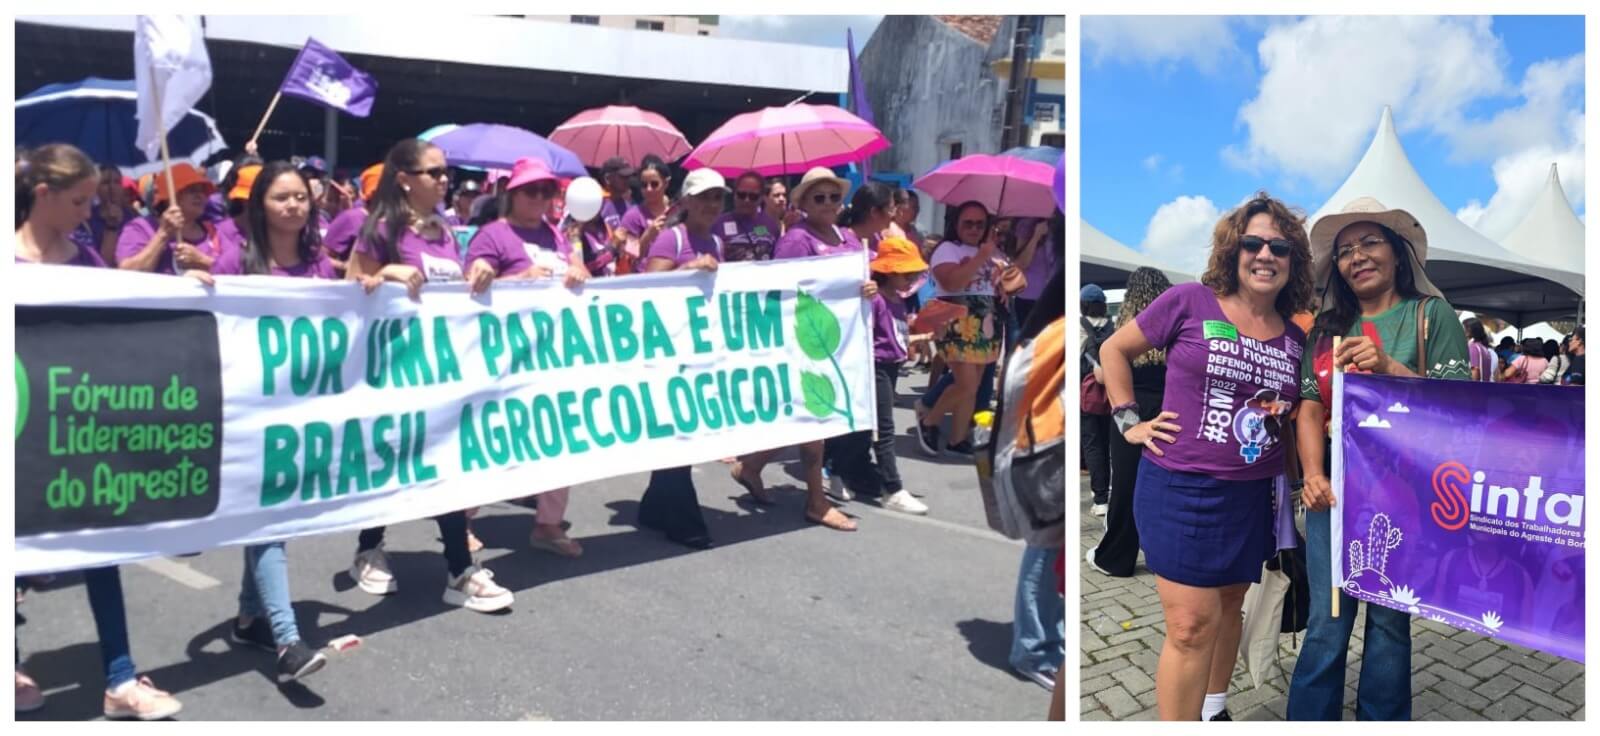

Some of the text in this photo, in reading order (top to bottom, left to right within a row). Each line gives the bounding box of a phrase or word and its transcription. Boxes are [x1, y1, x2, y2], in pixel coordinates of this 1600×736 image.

[257, 289, 785, 397] POR UMA PARAÍBA E UM
[1209, 339, 1240, 355] SOU
[1206, 363, 1283, 391] DEFENDO O SUS!
[1208, 353, 1253, 373] DEFENDO
[1255, 366, 1262, 376] A
[1210, 378, 1238, 391] 2022
[47, 366, 199, 413] Fórum de
[47, 415, 215, 457] Lideranças
[258, 362, 794, 508] BRASIL AGROECOLÓGICO!
[1203, 387, 1235, 444] #8M
[46, 455, 210, 516] do Agreste
[1430, 460, 1585, 531] Sinta
[1469, 522, 1585, 549] Municipais do Agreste da Bor
[1470, 513, 1581, 538] Sindicato dos Trabalhadores
